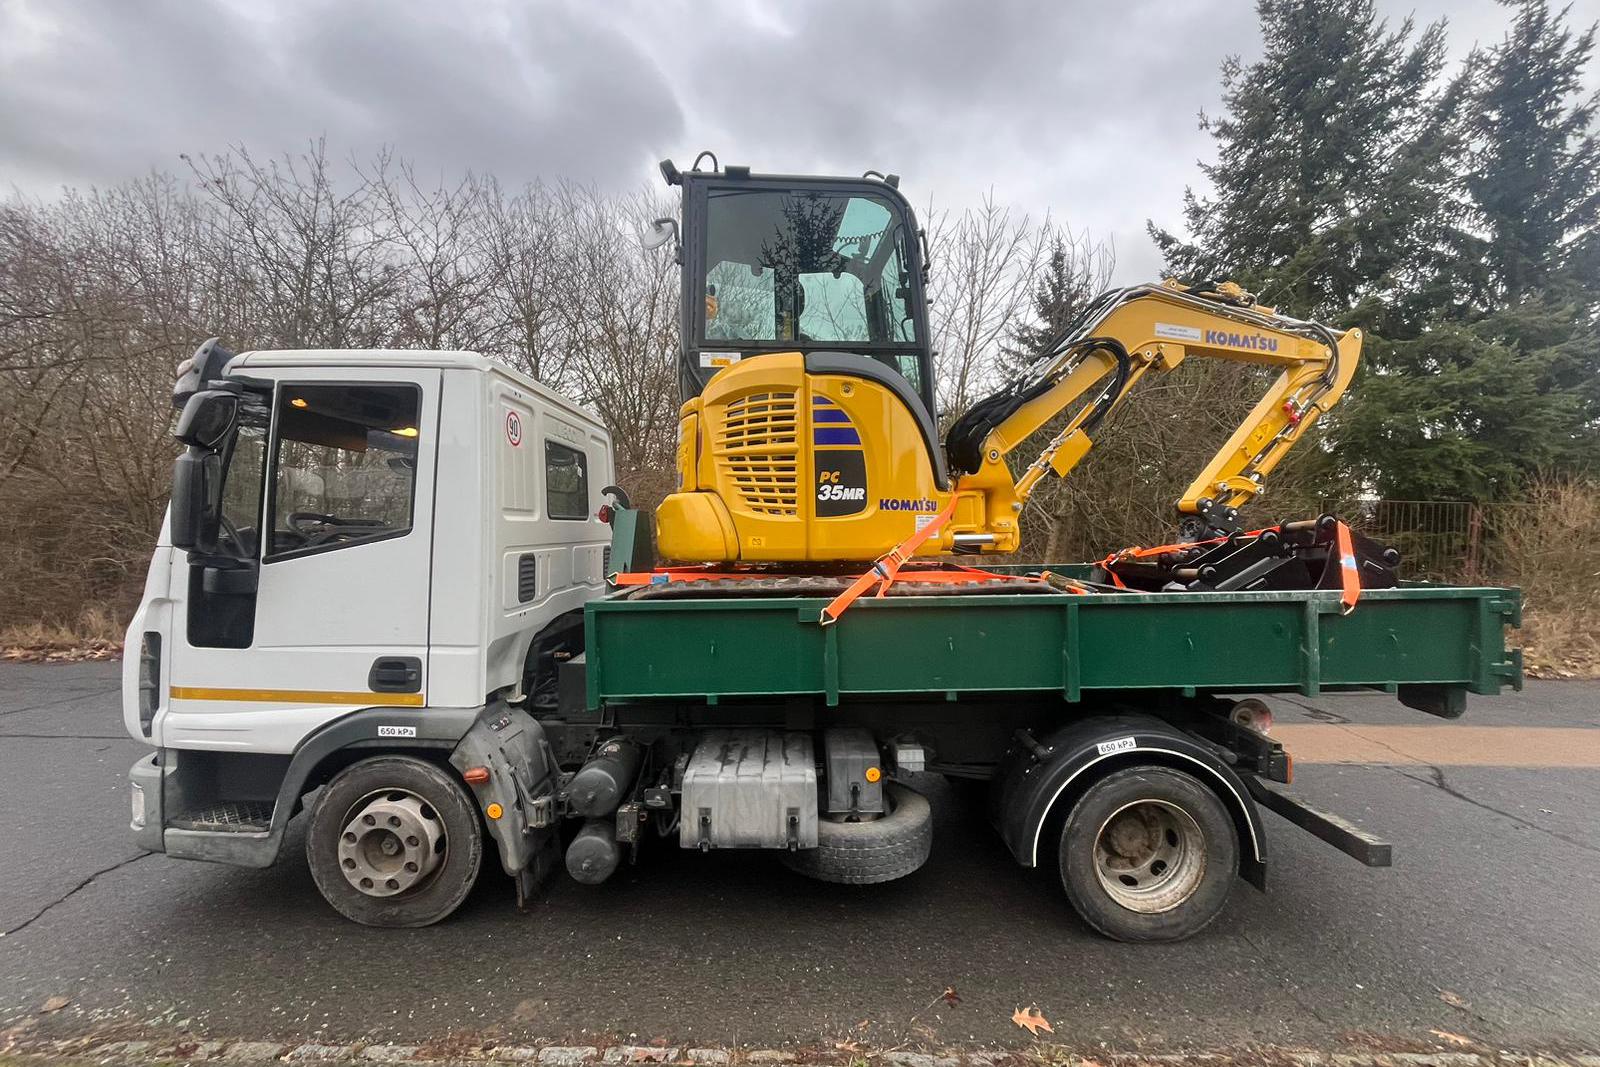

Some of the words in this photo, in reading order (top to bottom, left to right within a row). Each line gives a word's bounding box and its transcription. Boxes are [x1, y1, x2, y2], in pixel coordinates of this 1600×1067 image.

[1205, 329, 1278, 352] KOMATSU
[509, 417, 518, 438] 90
[819, 471, 840, 483] PC
[817, 484, 865, 500] 35MR
[879, 497, 937, 512] KOMATSU
[380, 727, 396, 736] 650
[397, 727, 414, 736] kPa
[1100, 743, 1116, 753] 650
[1117, 740, 1134, 749] kPa
